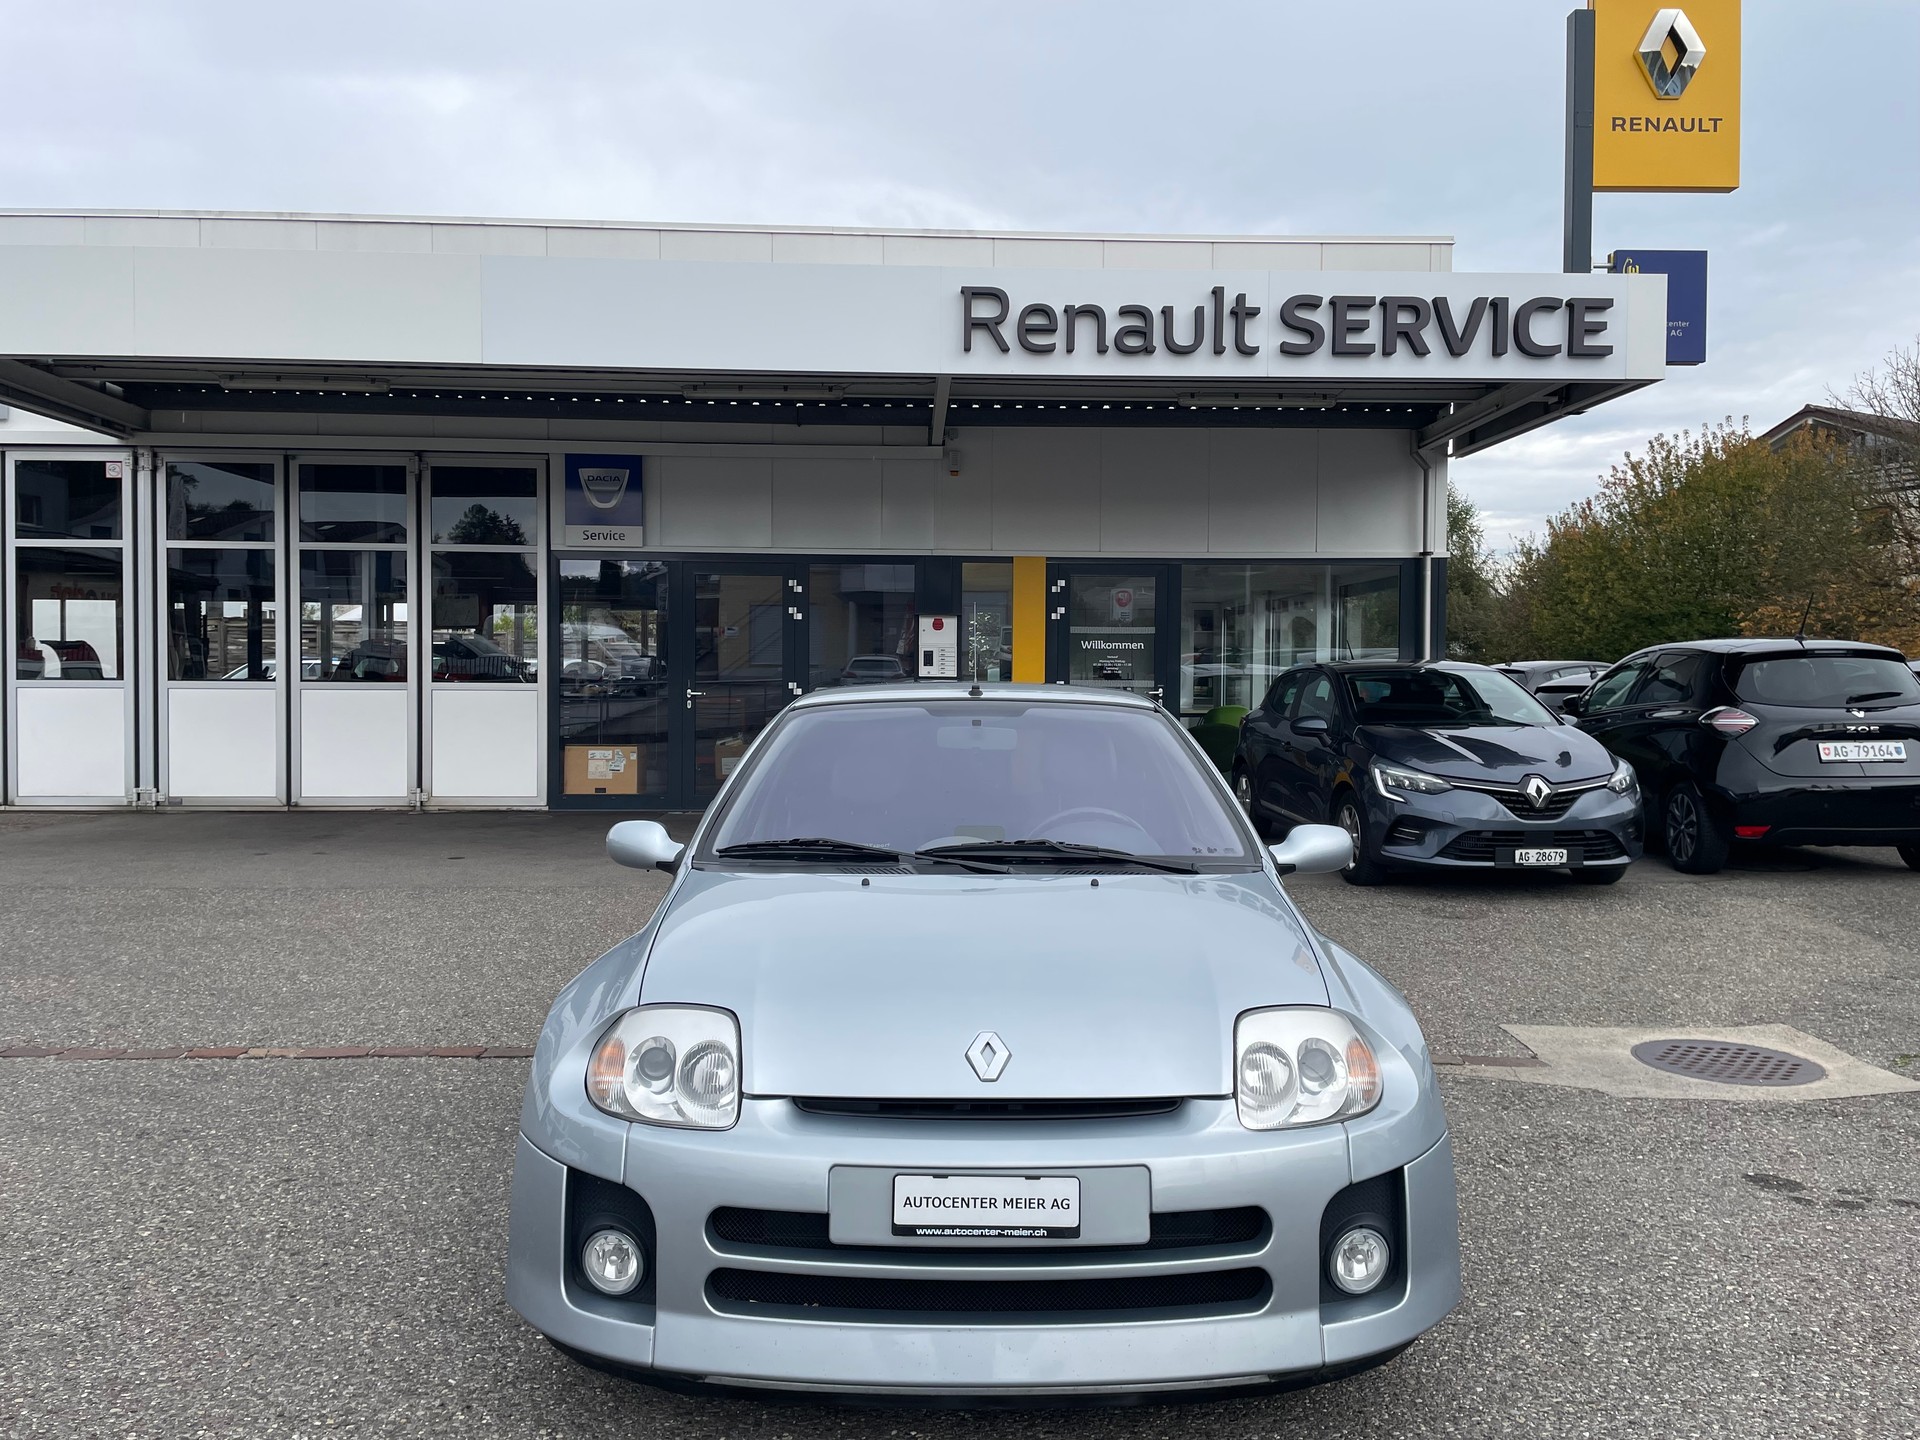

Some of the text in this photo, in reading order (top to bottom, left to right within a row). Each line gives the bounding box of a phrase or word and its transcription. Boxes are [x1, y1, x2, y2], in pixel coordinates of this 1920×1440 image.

[1611, 117, 1723, 132] RENAULT
[961, 286, 1614, 357] Renault SERVICE
[1667, 320, 1690, 328] enter
[1670, 329, 1683, 337] AG
[582, 530, 626, 541] Service
[1081, 640, 1145, 650] Willkommen
[903, 1196, 1071, 1210] AUTOCENTER MEIER AG
[916, 1228, 1047, 1237] www.autocenter-meier.ch
